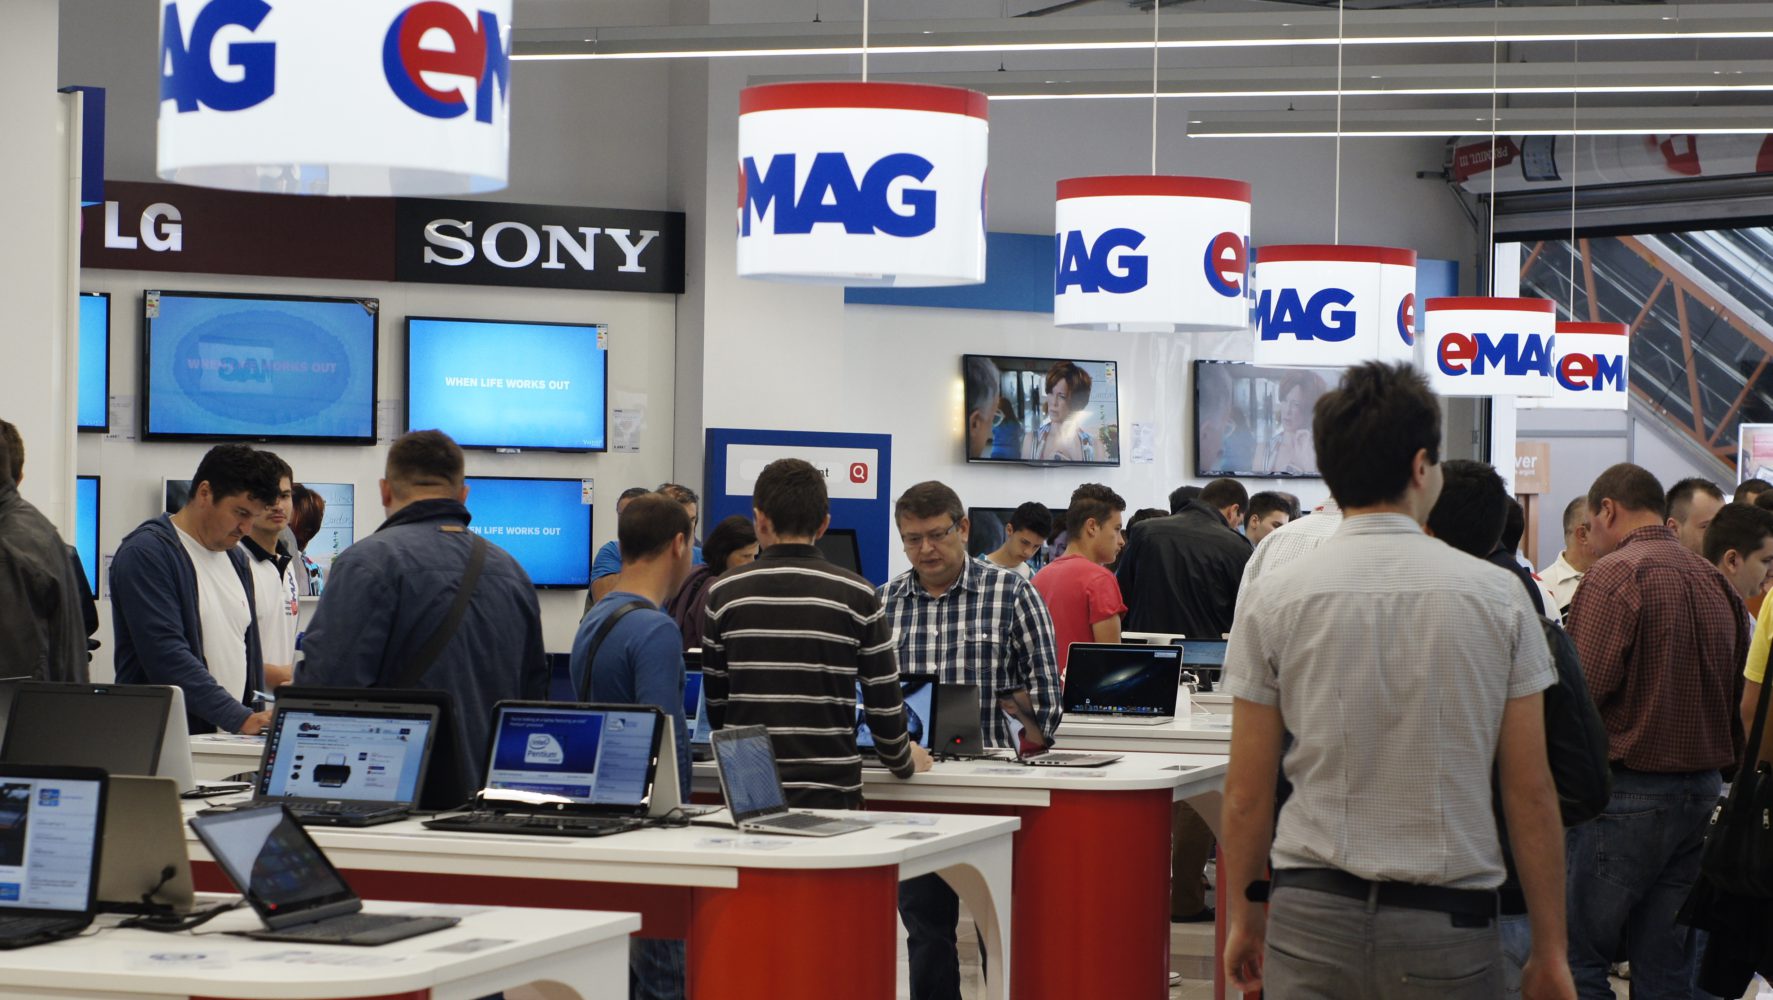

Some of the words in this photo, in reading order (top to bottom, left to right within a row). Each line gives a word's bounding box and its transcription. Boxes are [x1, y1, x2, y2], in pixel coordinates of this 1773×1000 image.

[738, 152, 937, 238] MAG
[104, 200, 183, 252] LG
[424, 218, 660, 273] SONY
[445, 376, 478, 388] WHEN
[480, 378, 504, 389] LIFE
[505, 379, 546, 390] WORKS
[548, 380, 570, 391] OUT
[484, 526, 504, 536] LIFE
[506, 526, 541, 536] WORKS
[542, 527, 561, 536] OUT
